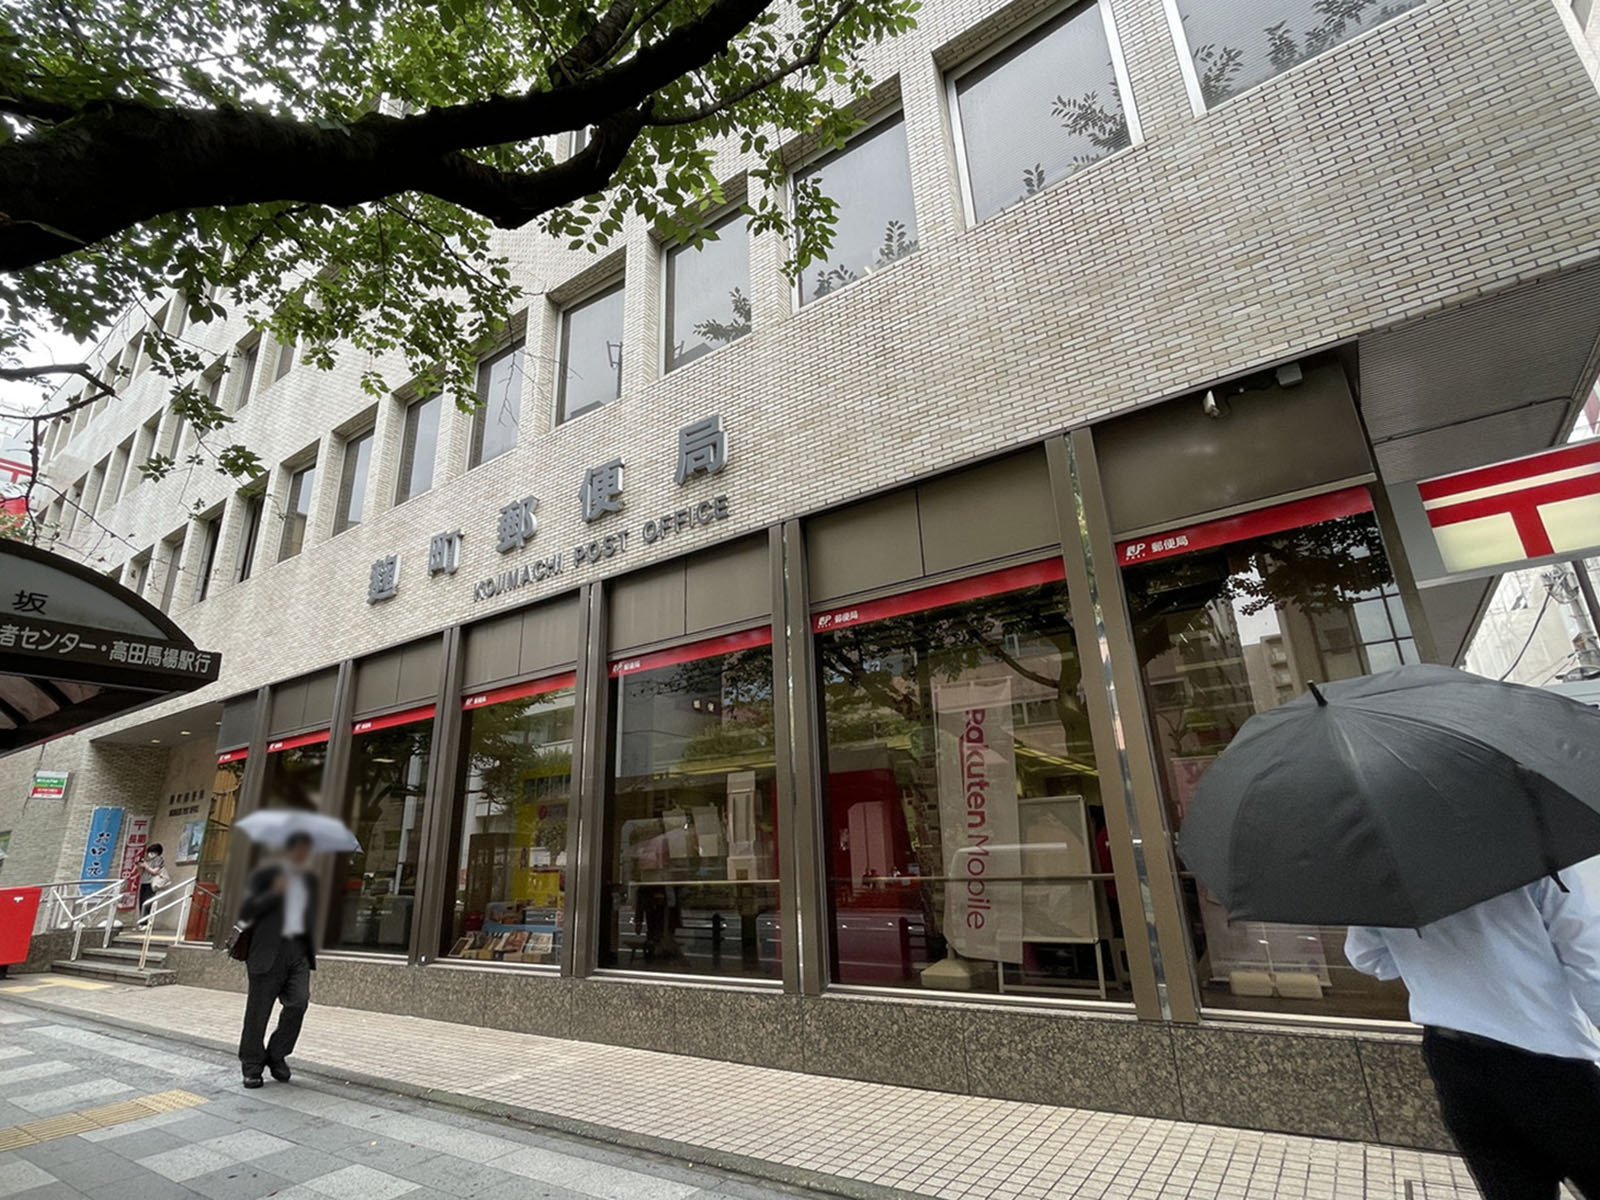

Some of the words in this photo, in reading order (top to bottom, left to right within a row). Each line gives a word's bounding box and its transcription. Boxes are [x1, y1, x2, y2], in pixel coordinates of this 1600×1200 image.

[473, 552, 565, 602] KOJIMACHI
[573, 530, 630, 568] POST
[642, 494, 731, 545] OFFICE
[12, 590, 49, 615] 坂
